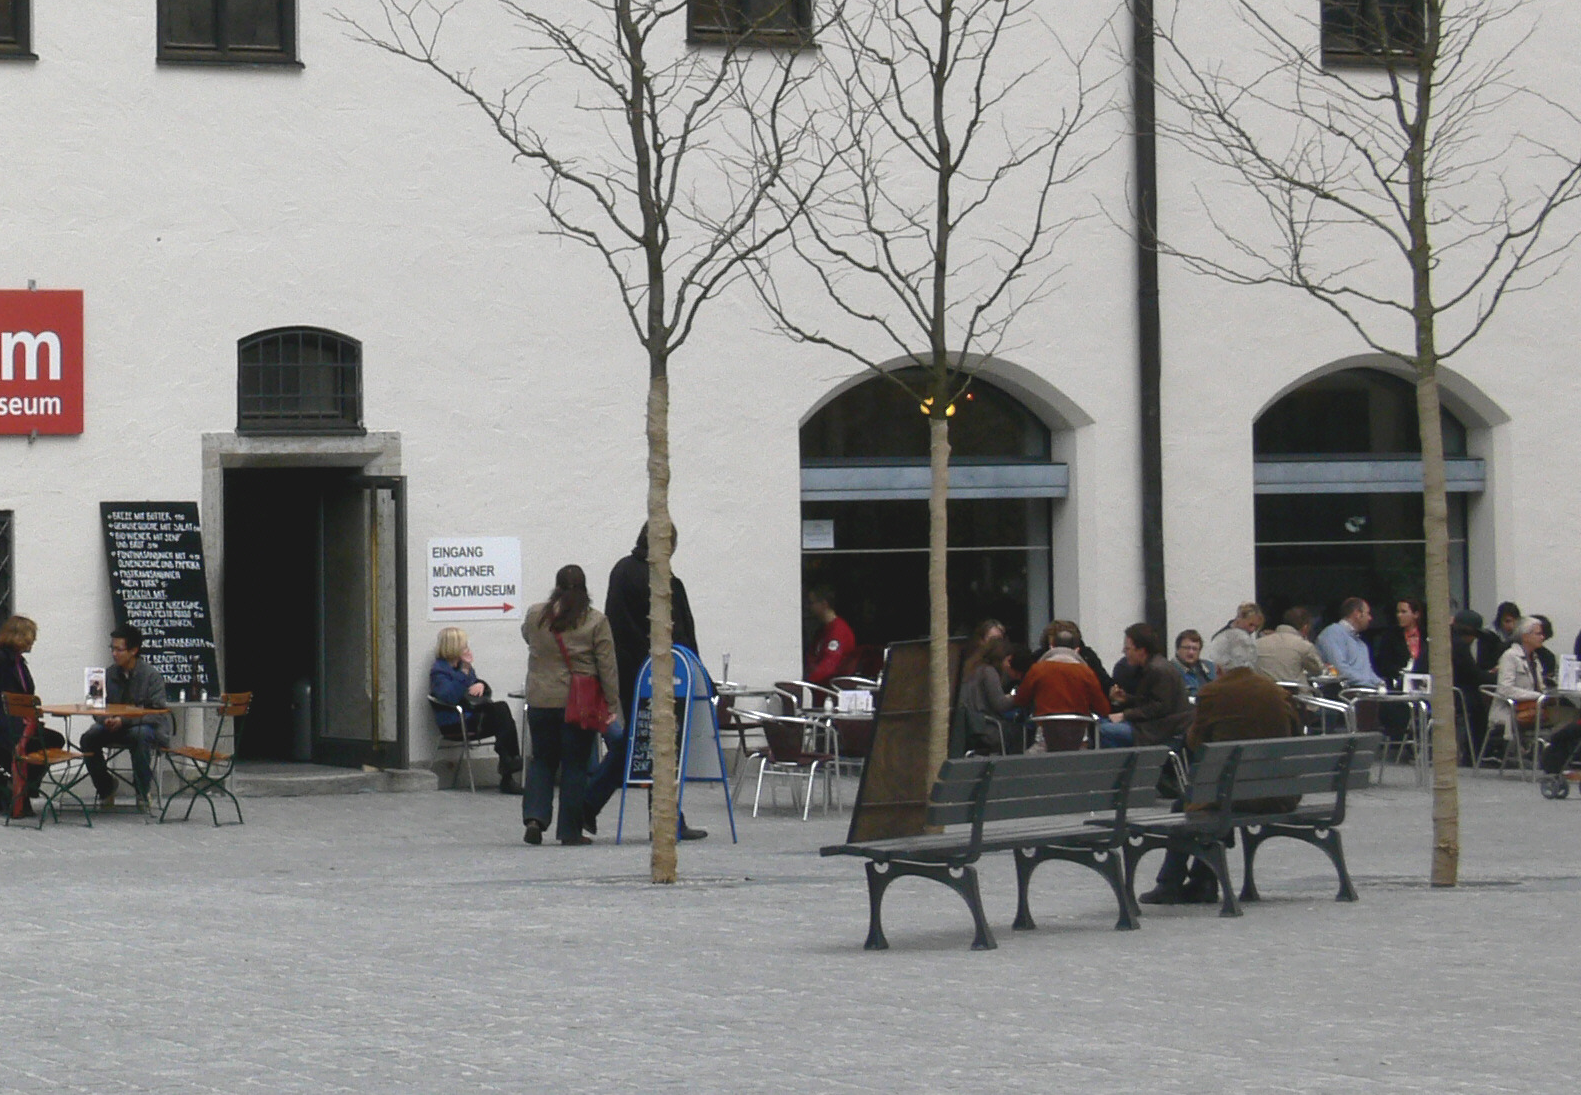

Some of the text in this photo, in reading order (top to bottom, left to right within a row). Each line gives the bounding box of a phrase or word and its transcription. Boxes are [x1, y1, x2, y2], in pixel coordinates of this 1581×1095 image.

[432, 546, 483, 558] EINGANG
[432, 564, 495, 577] MÜNCHNER
[432, 585, 516, 597] STADTMUSEUM
